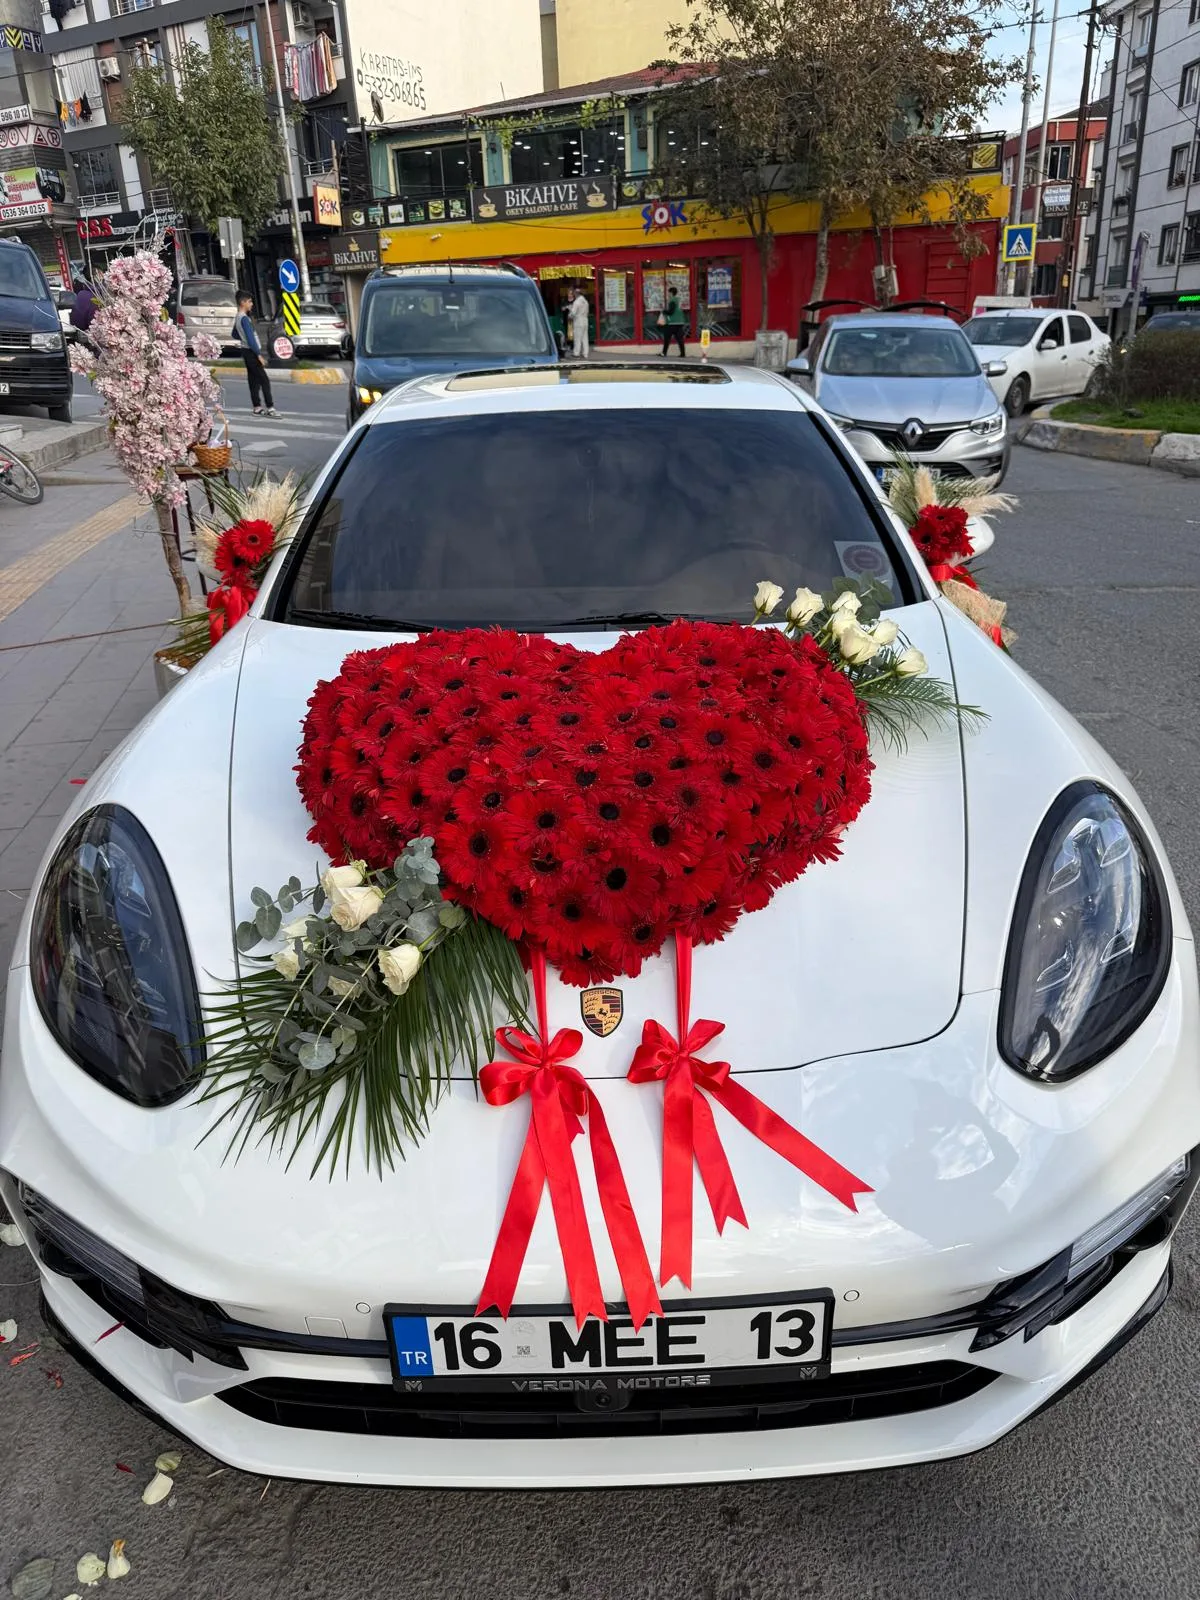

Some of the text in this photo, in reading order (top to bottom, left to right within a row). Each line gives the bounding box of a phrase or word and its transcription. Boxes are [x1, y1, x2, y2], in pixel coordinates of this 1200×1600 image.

[434, 1311, 816, 1371] 16 MEE 13
[402, 1350, 428, 1365] TR
[512, 1374, 711, 1391] VERONA MOTORS
